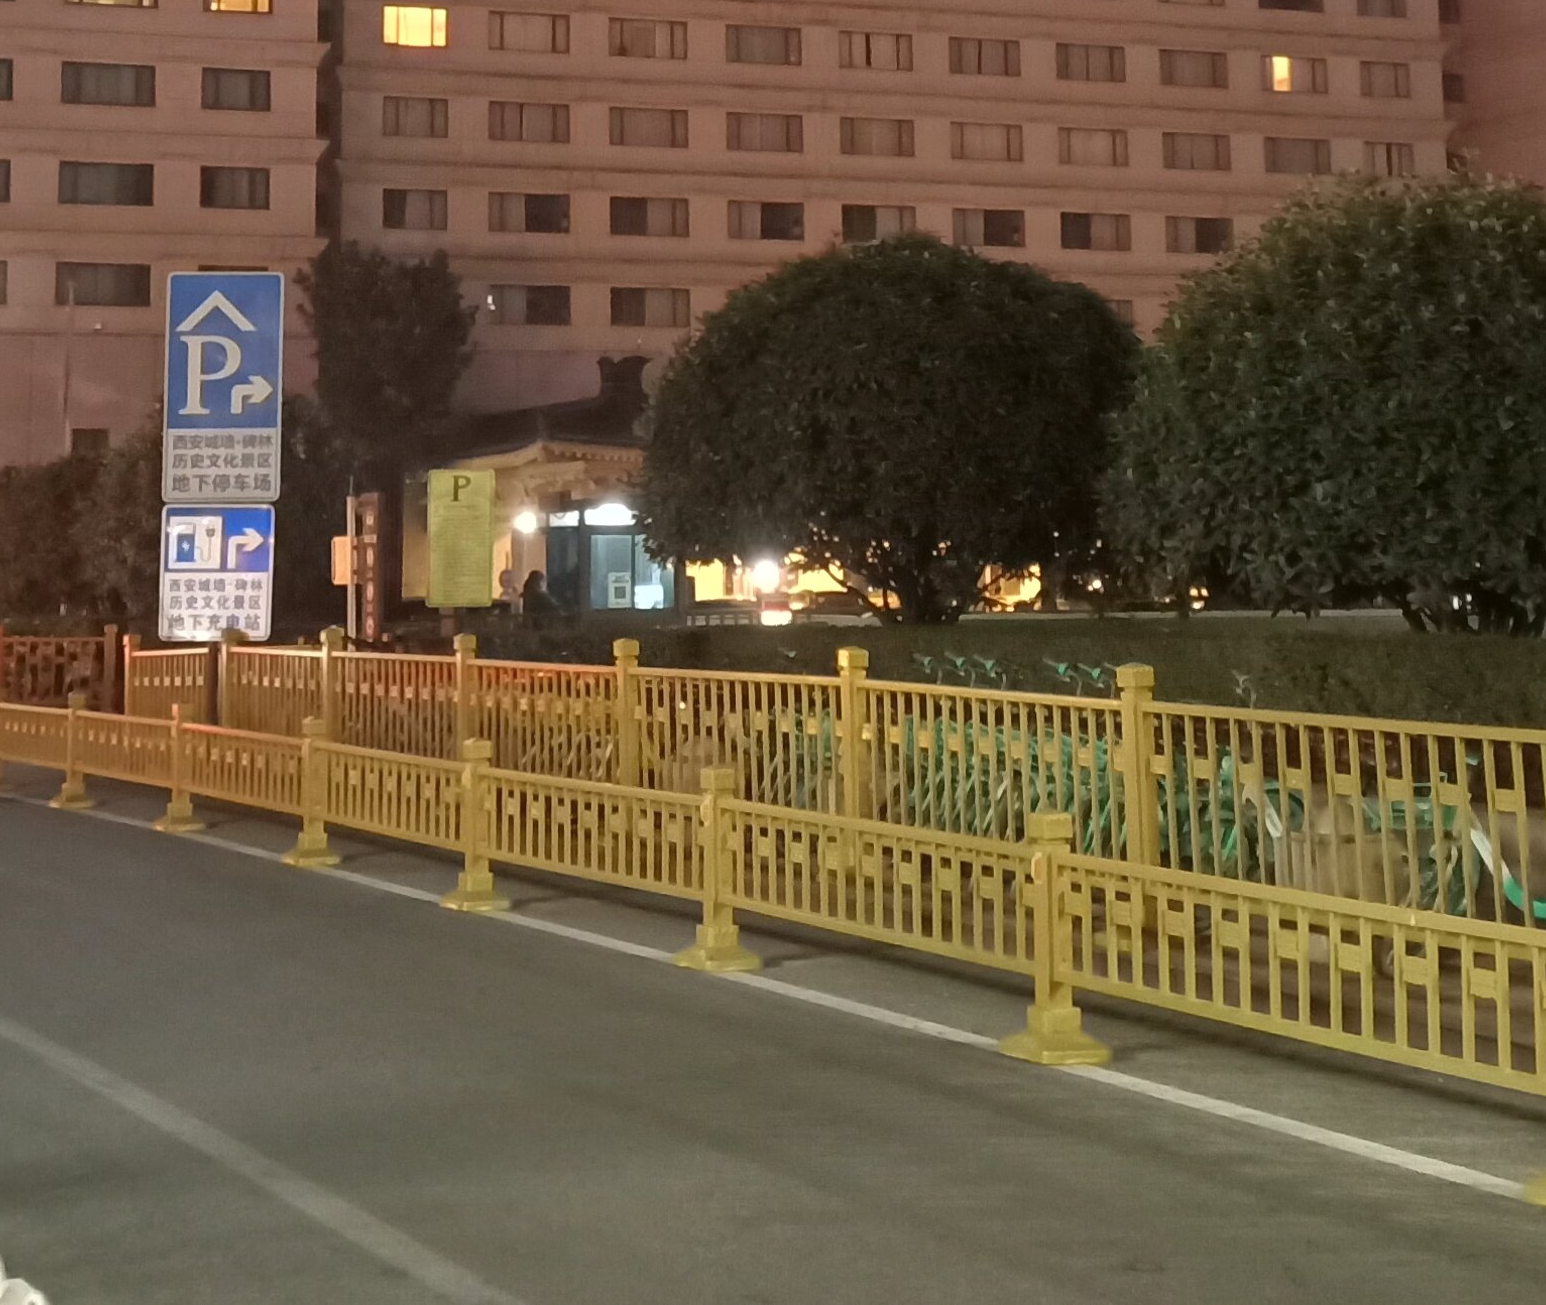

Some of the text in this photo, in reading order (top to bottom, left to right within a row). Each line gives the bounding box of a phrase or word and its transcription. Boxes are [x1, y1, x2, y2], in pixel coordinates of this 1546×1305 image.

[178, 335, 241, 415] P
[172, 453, 272, 469] 历史文化景区
[172, 473, 271, 493] 地下停车场
[451, 475, 472, 502] P
[169, 595, 261, 610] 历史文化景区
[168, 613, 261, 631] 地下充电站
